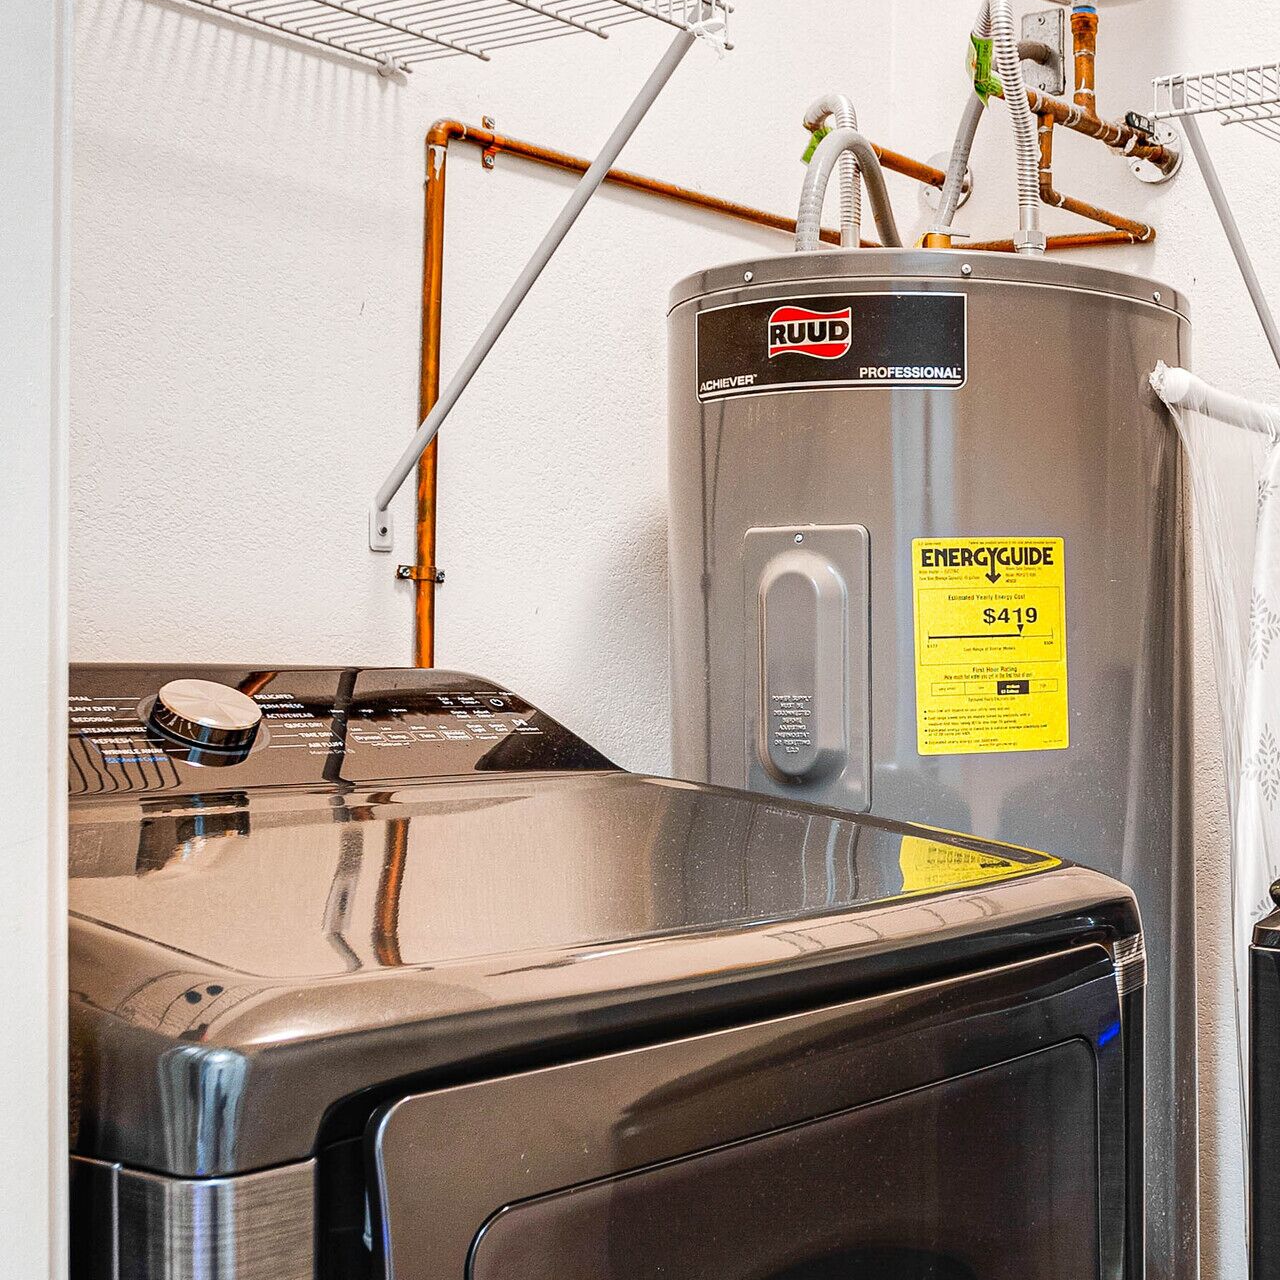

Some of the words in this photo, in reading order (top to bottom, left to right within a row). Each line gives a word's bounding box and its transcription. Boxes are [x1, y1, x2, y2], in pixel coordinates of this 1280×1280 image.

[770, 319, 849, 346] RUUD
[860, 366, 961, 379] PROFESSIONAL
[699, 374, 757, 393] ACHIEVER
[921, 546, 1054, 568] ENERGYGUIDE
[983, 607, 1038, 625] $419
